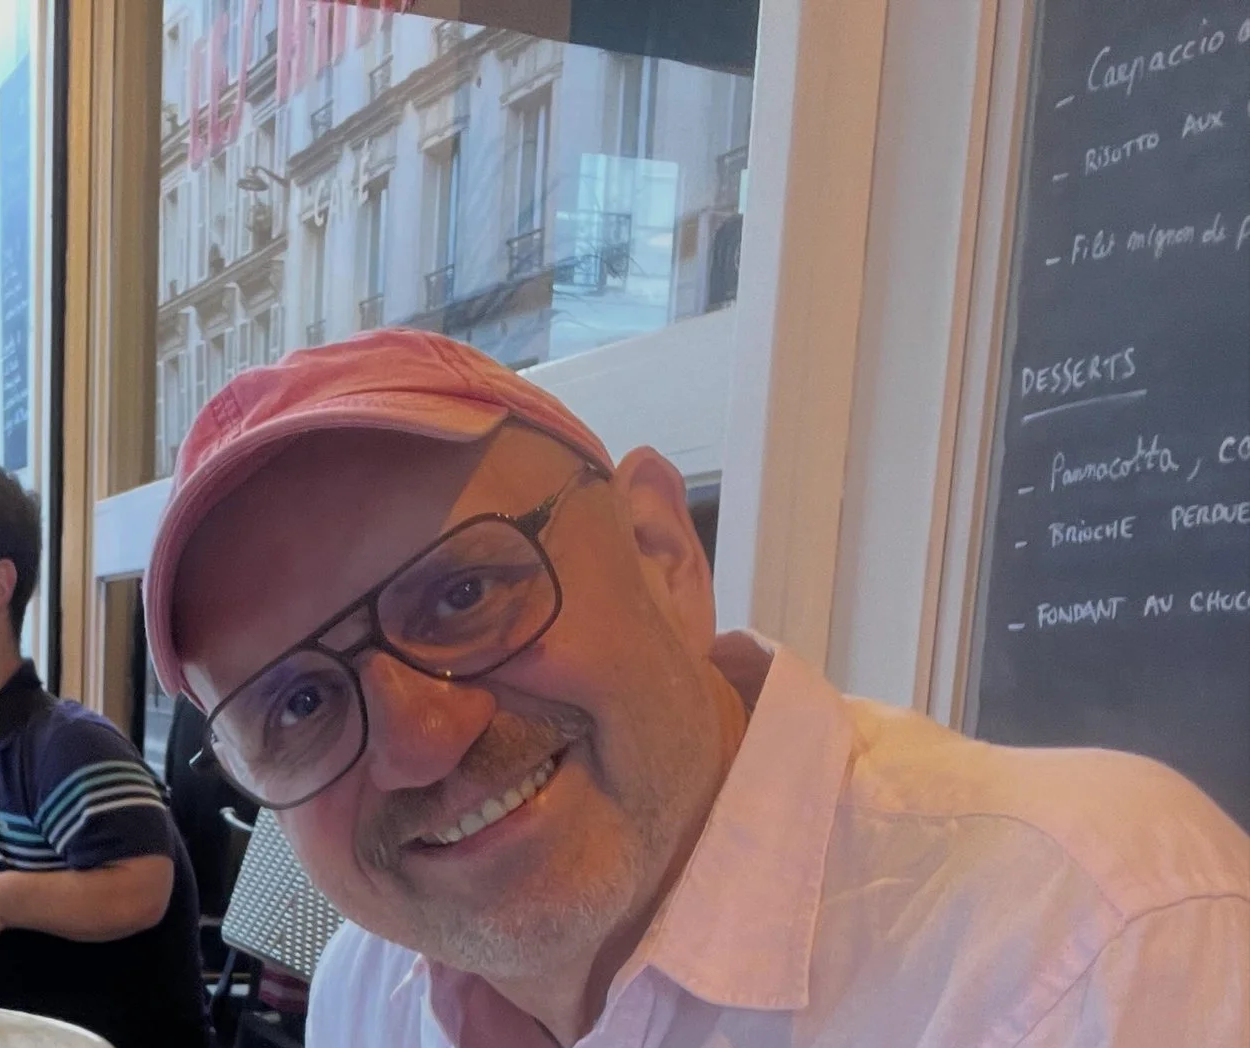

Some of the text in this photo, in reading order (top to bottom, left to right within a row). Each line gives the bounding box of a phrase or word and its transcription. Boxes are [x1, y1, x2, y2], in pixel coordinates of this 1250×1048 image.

[1182, 110, 1224, 139] AUX
[314, 138, 371, 228] CAÉ
[1071, 229, 1116, 265] Filet
[1127, 223, 1195, 259] mignon
[1021, 346, 1136, 397] DESSERTS
[1171, 501, 1250, 532] PERDUE
[1037, 589, 1250, 629] FONDANT AU CHOC
